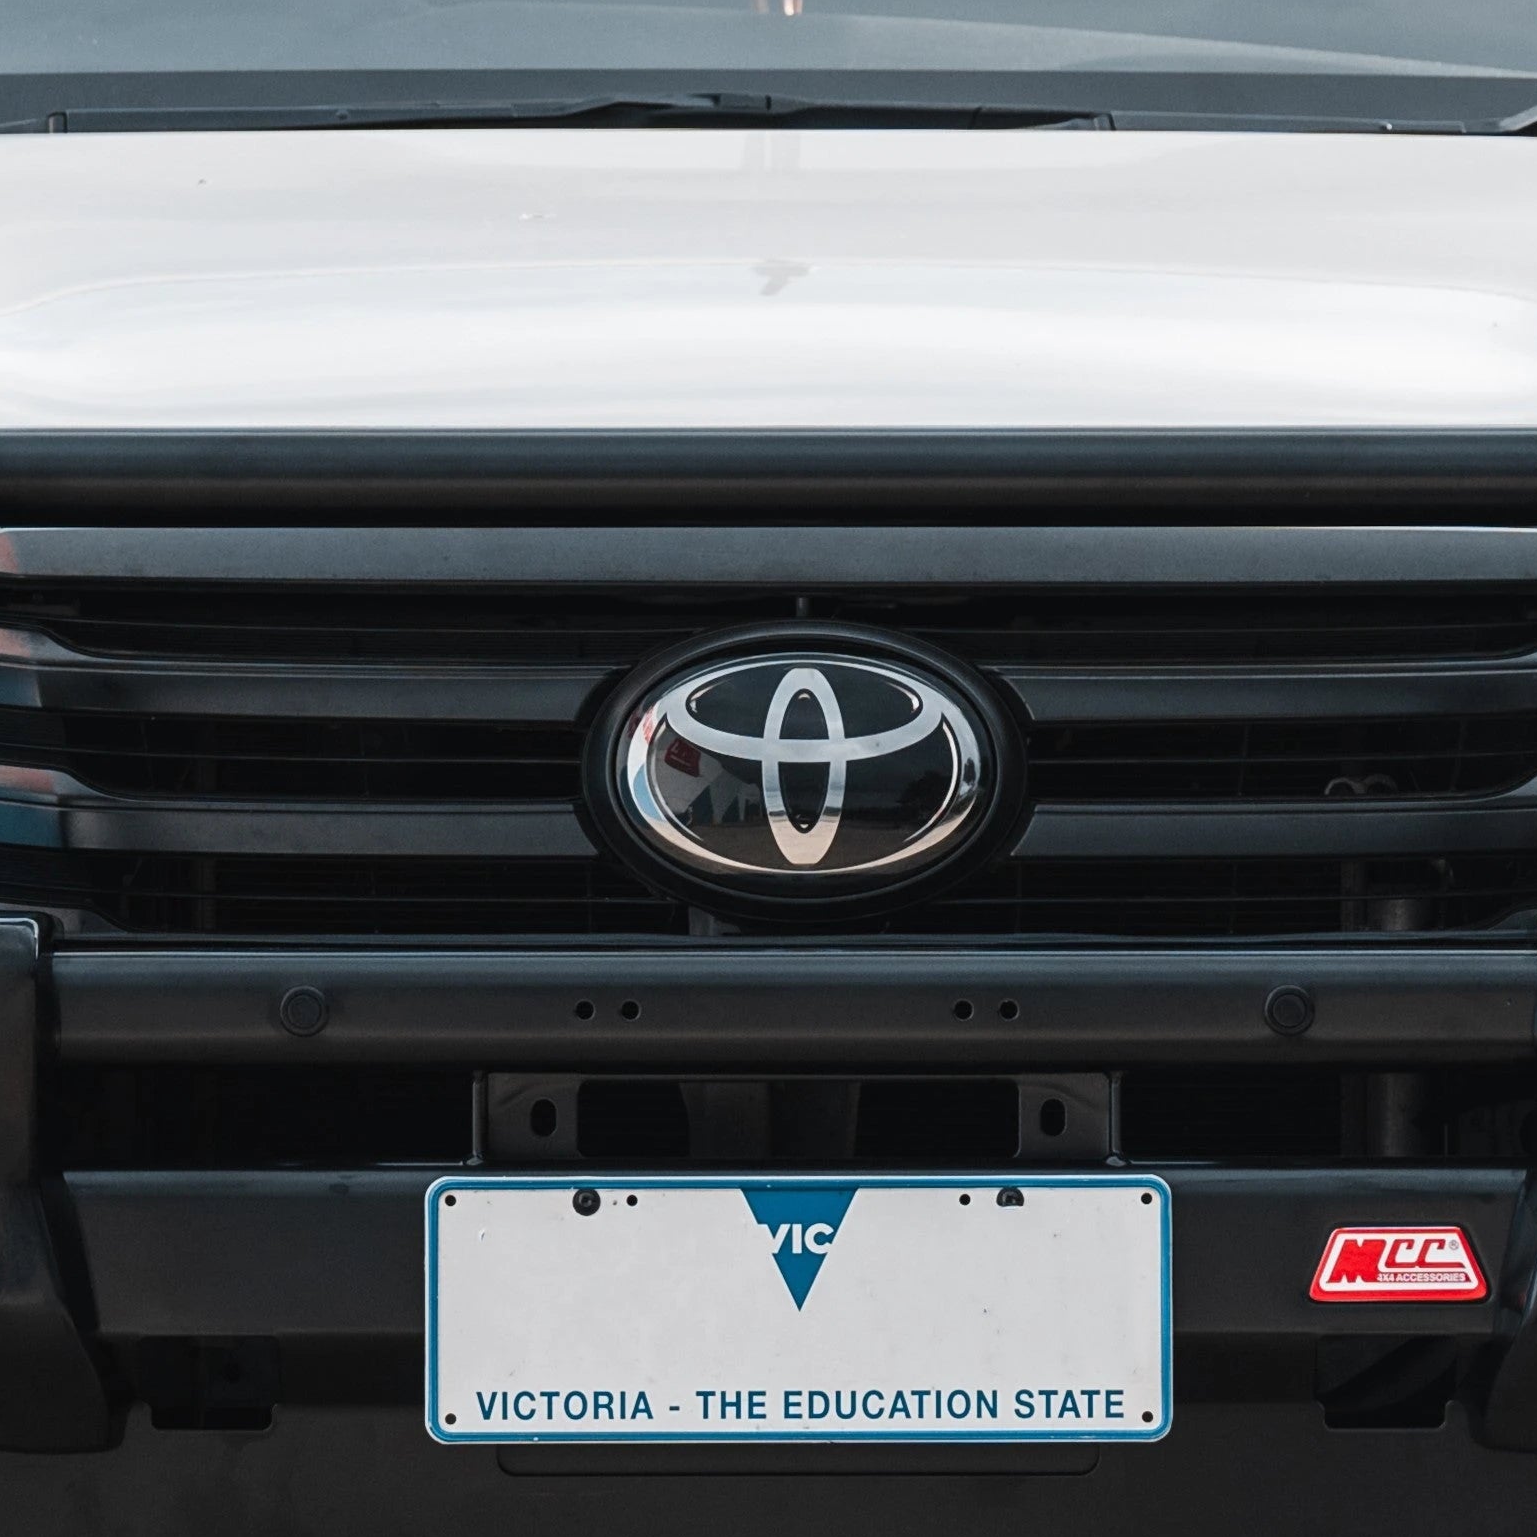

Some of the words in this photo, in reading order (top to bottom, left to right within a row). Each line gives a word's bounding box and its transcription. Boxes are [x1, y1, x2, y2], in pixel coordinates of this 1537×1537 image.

[757, 1222, 834, 1254] VIC
[1326, 1238, 1466, 1283] MCC
[1396, 1272, 1466, 1282] ACCESSORIES
[476, 1390, 654, 1420] VICTORIA
[695, 1390, 767, 1419] THE
[783, 1389, 998, 1419] EDUCATION
[1014, 1389, 1124, 1418] STATE
